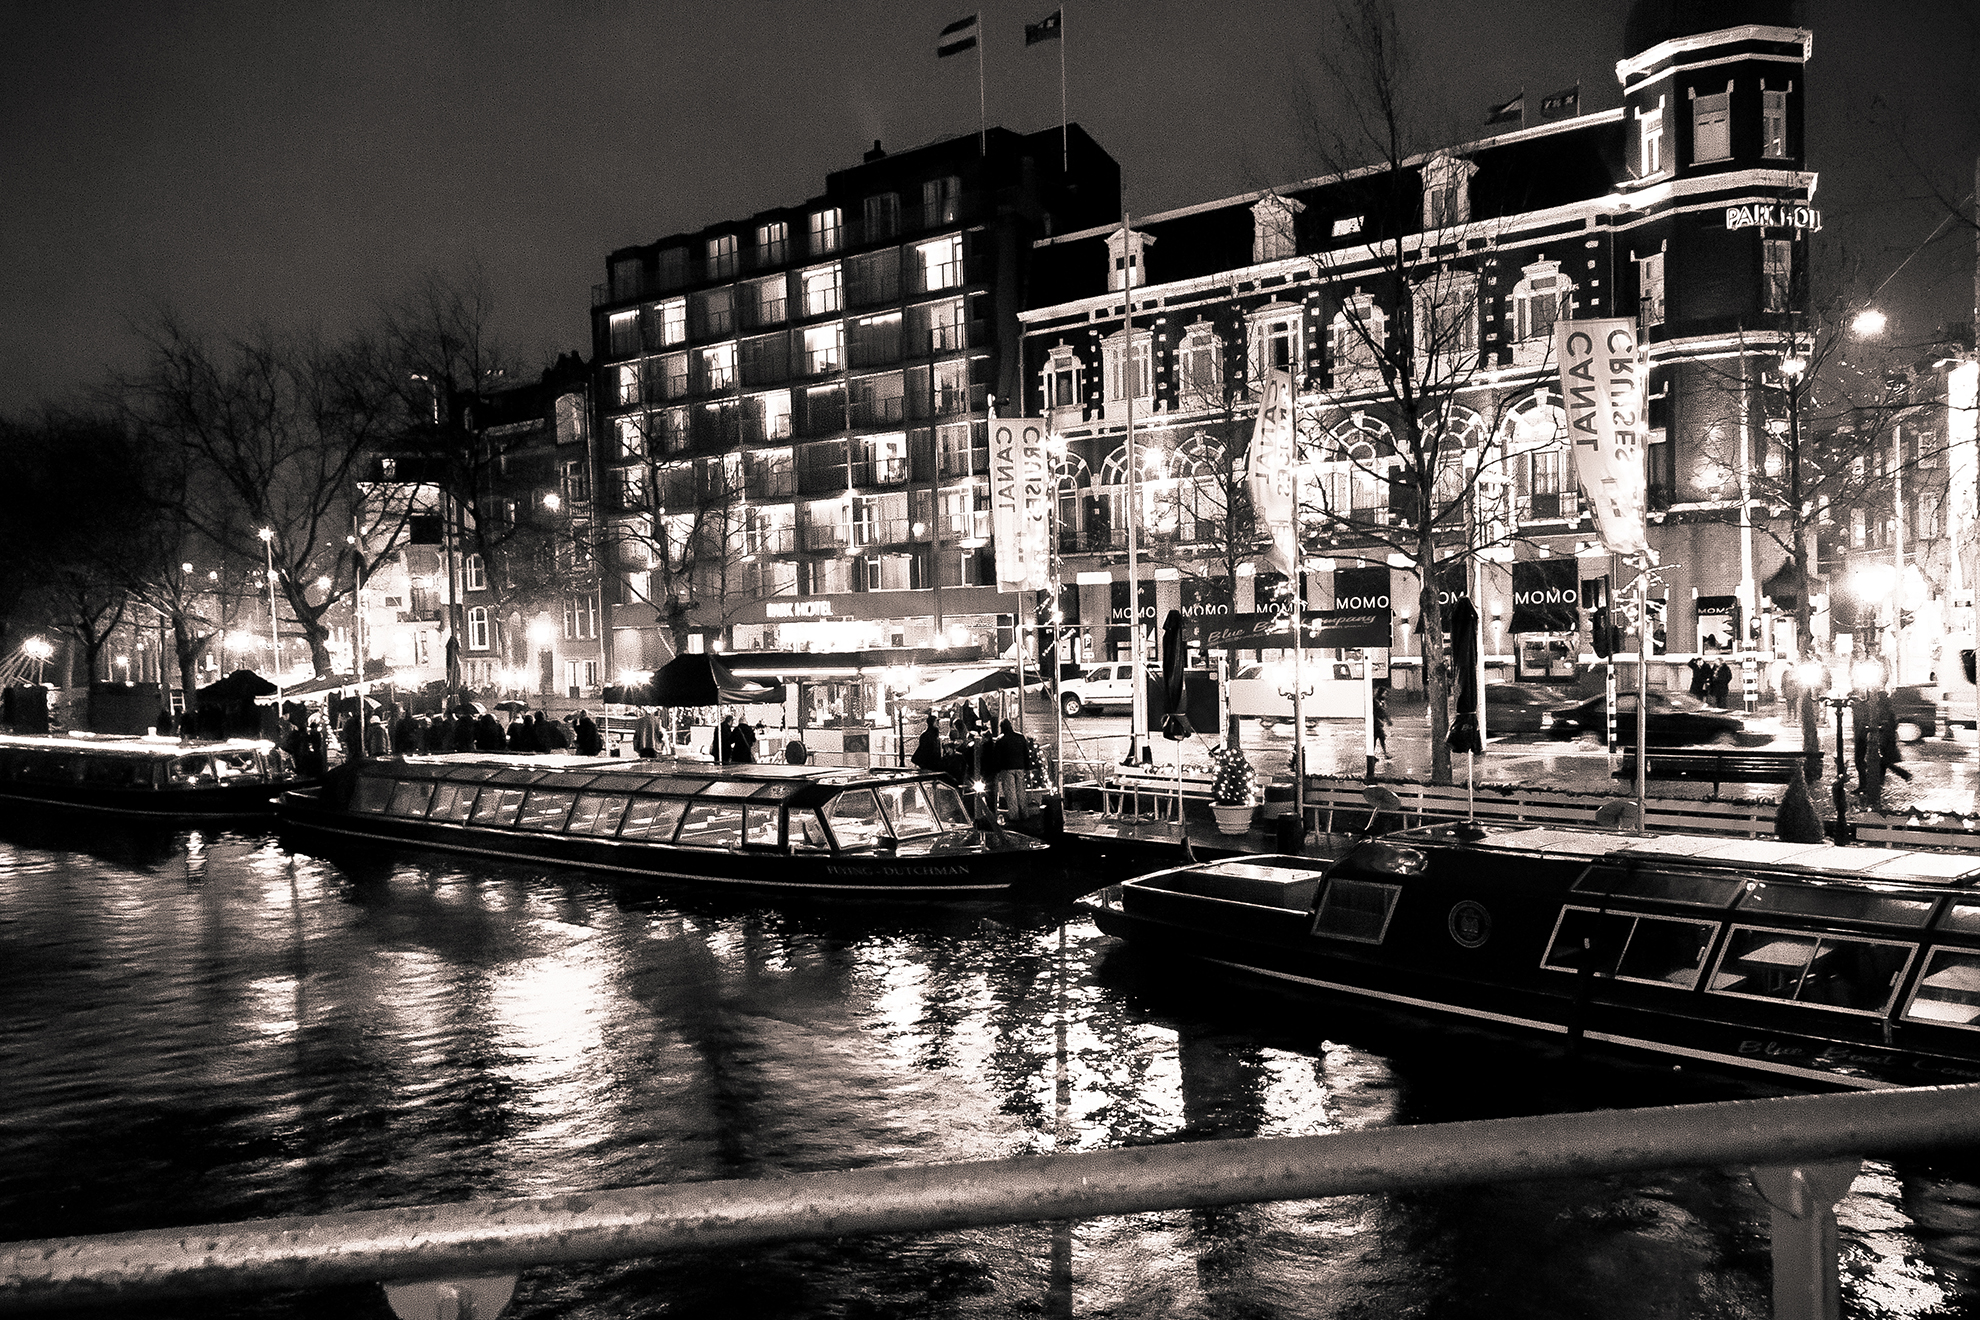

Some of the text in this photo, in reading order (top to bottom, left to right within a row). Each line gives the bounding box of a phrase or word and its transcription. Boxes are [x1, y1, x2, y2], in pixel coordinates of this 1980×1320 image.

[1336, 595, 1390, 610] MOMO
[1515, 589, 1577, 605] MOMO
[795, 600, 834, 616] HOTEL
[1112, 606, 1156, 619] MOMO
[1181, 605, 1229, 616] MOMO
[1697, 607, 1730, 615] MOM
[1207, 628, 1245, 643] Blue
[1301, 615, 1376, 626] Cmpany
[826, 865, 873, 876] FLYING
[883, 865, 970, 877] DUTCHMAN
[1737, 1039, 1804, 1057] Blue
[1820, 1046, 1898, 1066] Boat
